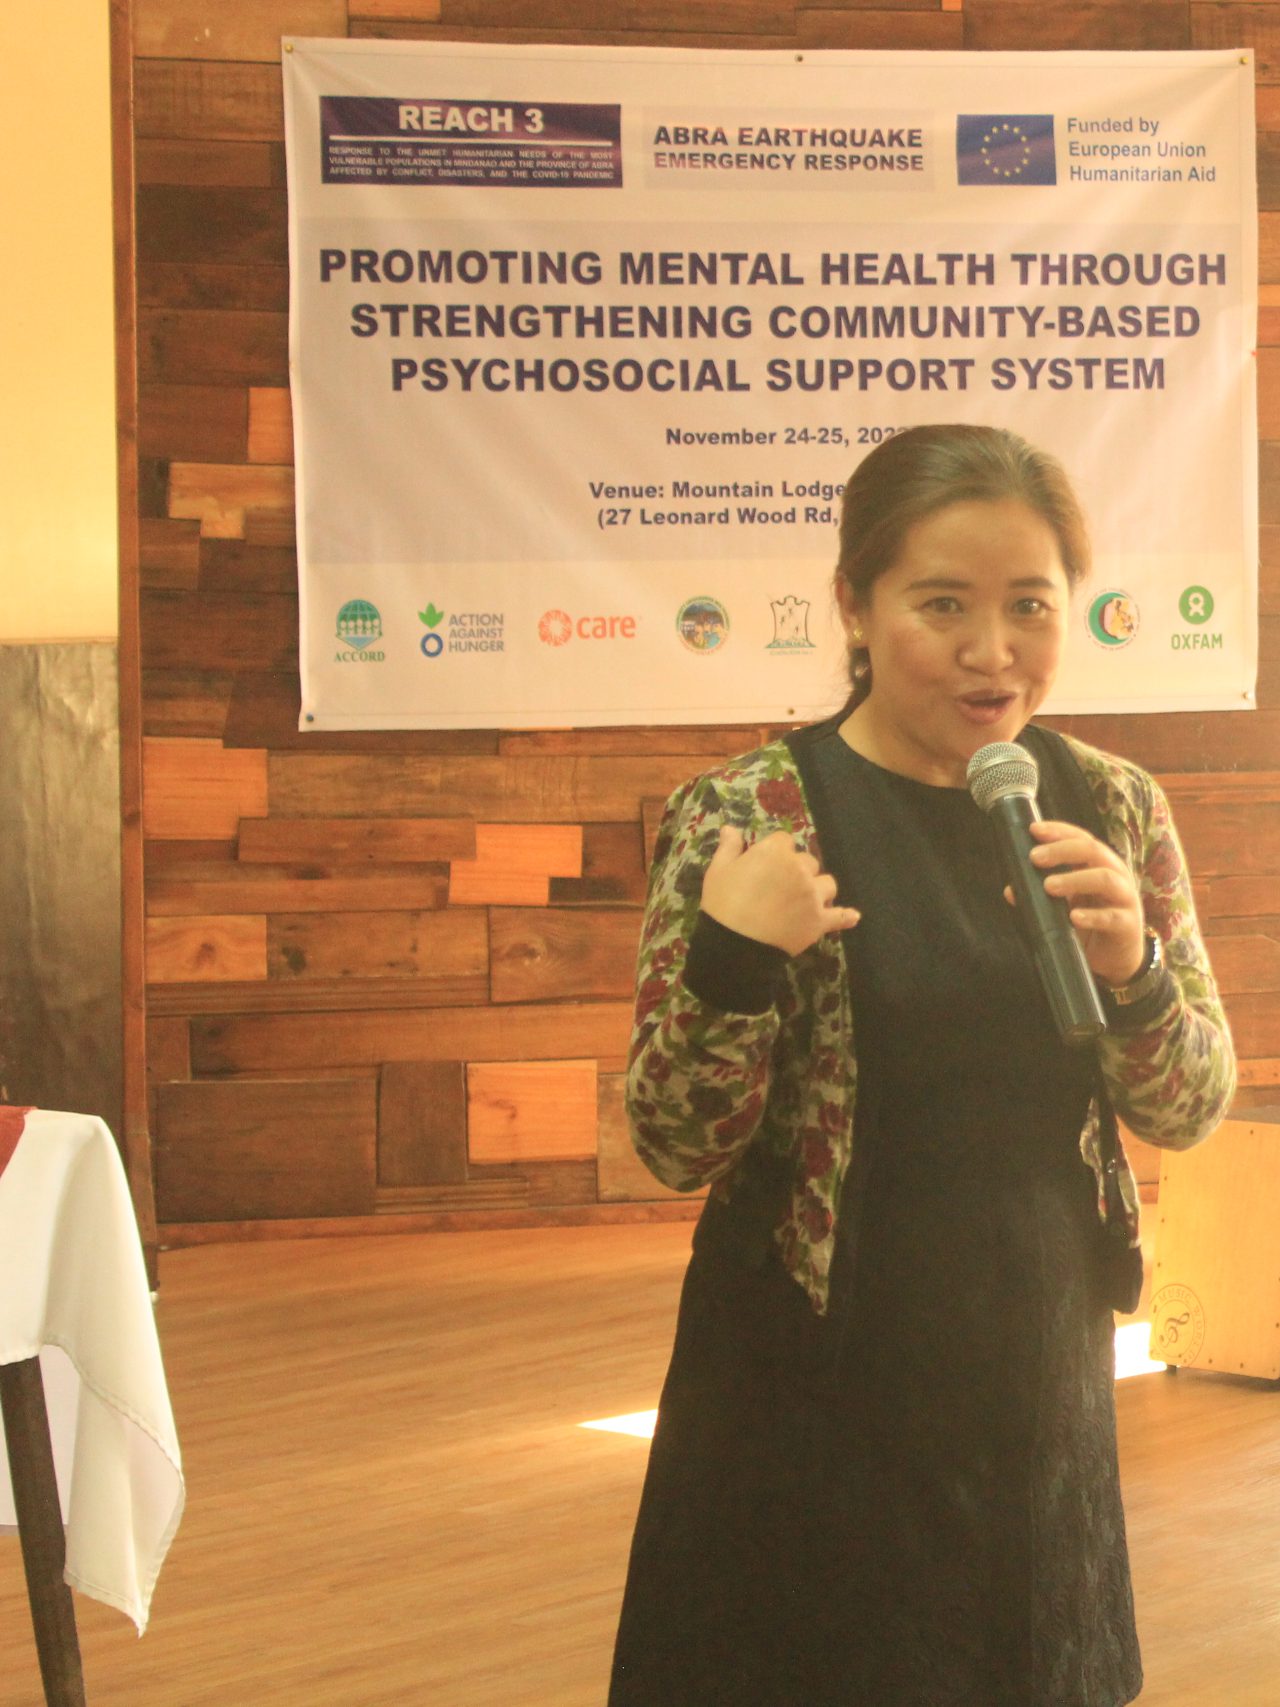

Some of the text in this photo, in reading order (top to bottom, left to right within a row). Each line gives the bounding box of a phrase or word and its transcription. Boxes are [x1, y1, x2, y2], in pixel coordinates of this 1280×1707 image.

[399, 105, 545, 134] REACH 3
[1067, 117, 1159, 137] Funded by
[653, 126, 923, 149] ABRA EARTHQUAKE
[329, 146, 373, 156] RESPONSE
[379, 147, 390, 156] TO
[397, 148, 412, 156] THE
[453, 148, 513, 158] HUMANITARIAN
[519, 150, 546, 158] NEEDS
[552, 151, 562, 159] OF
[570, 151, 585, 159] THE
[590, 152, 613, 160] MOST
[1069, 141, 1206, 161] European Union
[329, 157, 383, 166] VULNERABLE
[385, 158, 441, 167] POPULATIONS
[444, 159, 452, 167] IN
[498, 160, 516, 168] AND
[519, 160, 535, 168] THE
[536, 160, 577, 168] PROVINCE
[578, 160, 590, 169] OF
[592, 161, 613, 169] ABRA
[654, 152, 924, 172] EMERGENCY RESPONSE
[329, 167, 372, 176] AFFECTED
[376, 168, 388, 176] BY
[490, 170, 507, 178] AND
[513, 170, 528, 178] THE
[573, 171, 613, 180] PANDEMIC
[1070, 166, 1216, 183] Humanitarian Aid
[320, 249, 1227, 286] PROMOTING MENTAL HEALTH THROUGH
[350, 304, 1200, 339] STRENGTHENING COMMUNITY-BASED
[392, 357, 1165, 392] PSYCHOSOCIAL SUPPORT SYSTEM
[665, 427, 777, 445] November
[783, 427, 850, 447] 24-25,
[588, 480, 846, 501] Venue: Mountain Lodge
[597, 506, 839, 529] (27 Leonard Wood Rd,
[448, 613, 504, 626] ACTION
[576, 615, 637, 639] care
[449, 627, 504, 639] AGAINST
[1170, 633, 1223, 650] OXFAM
[334, 650, 386, 663] ACCORD
[449, 640, 505, 653] HUNGER
[1158, 1287, 1192, 1304] MUSIC
